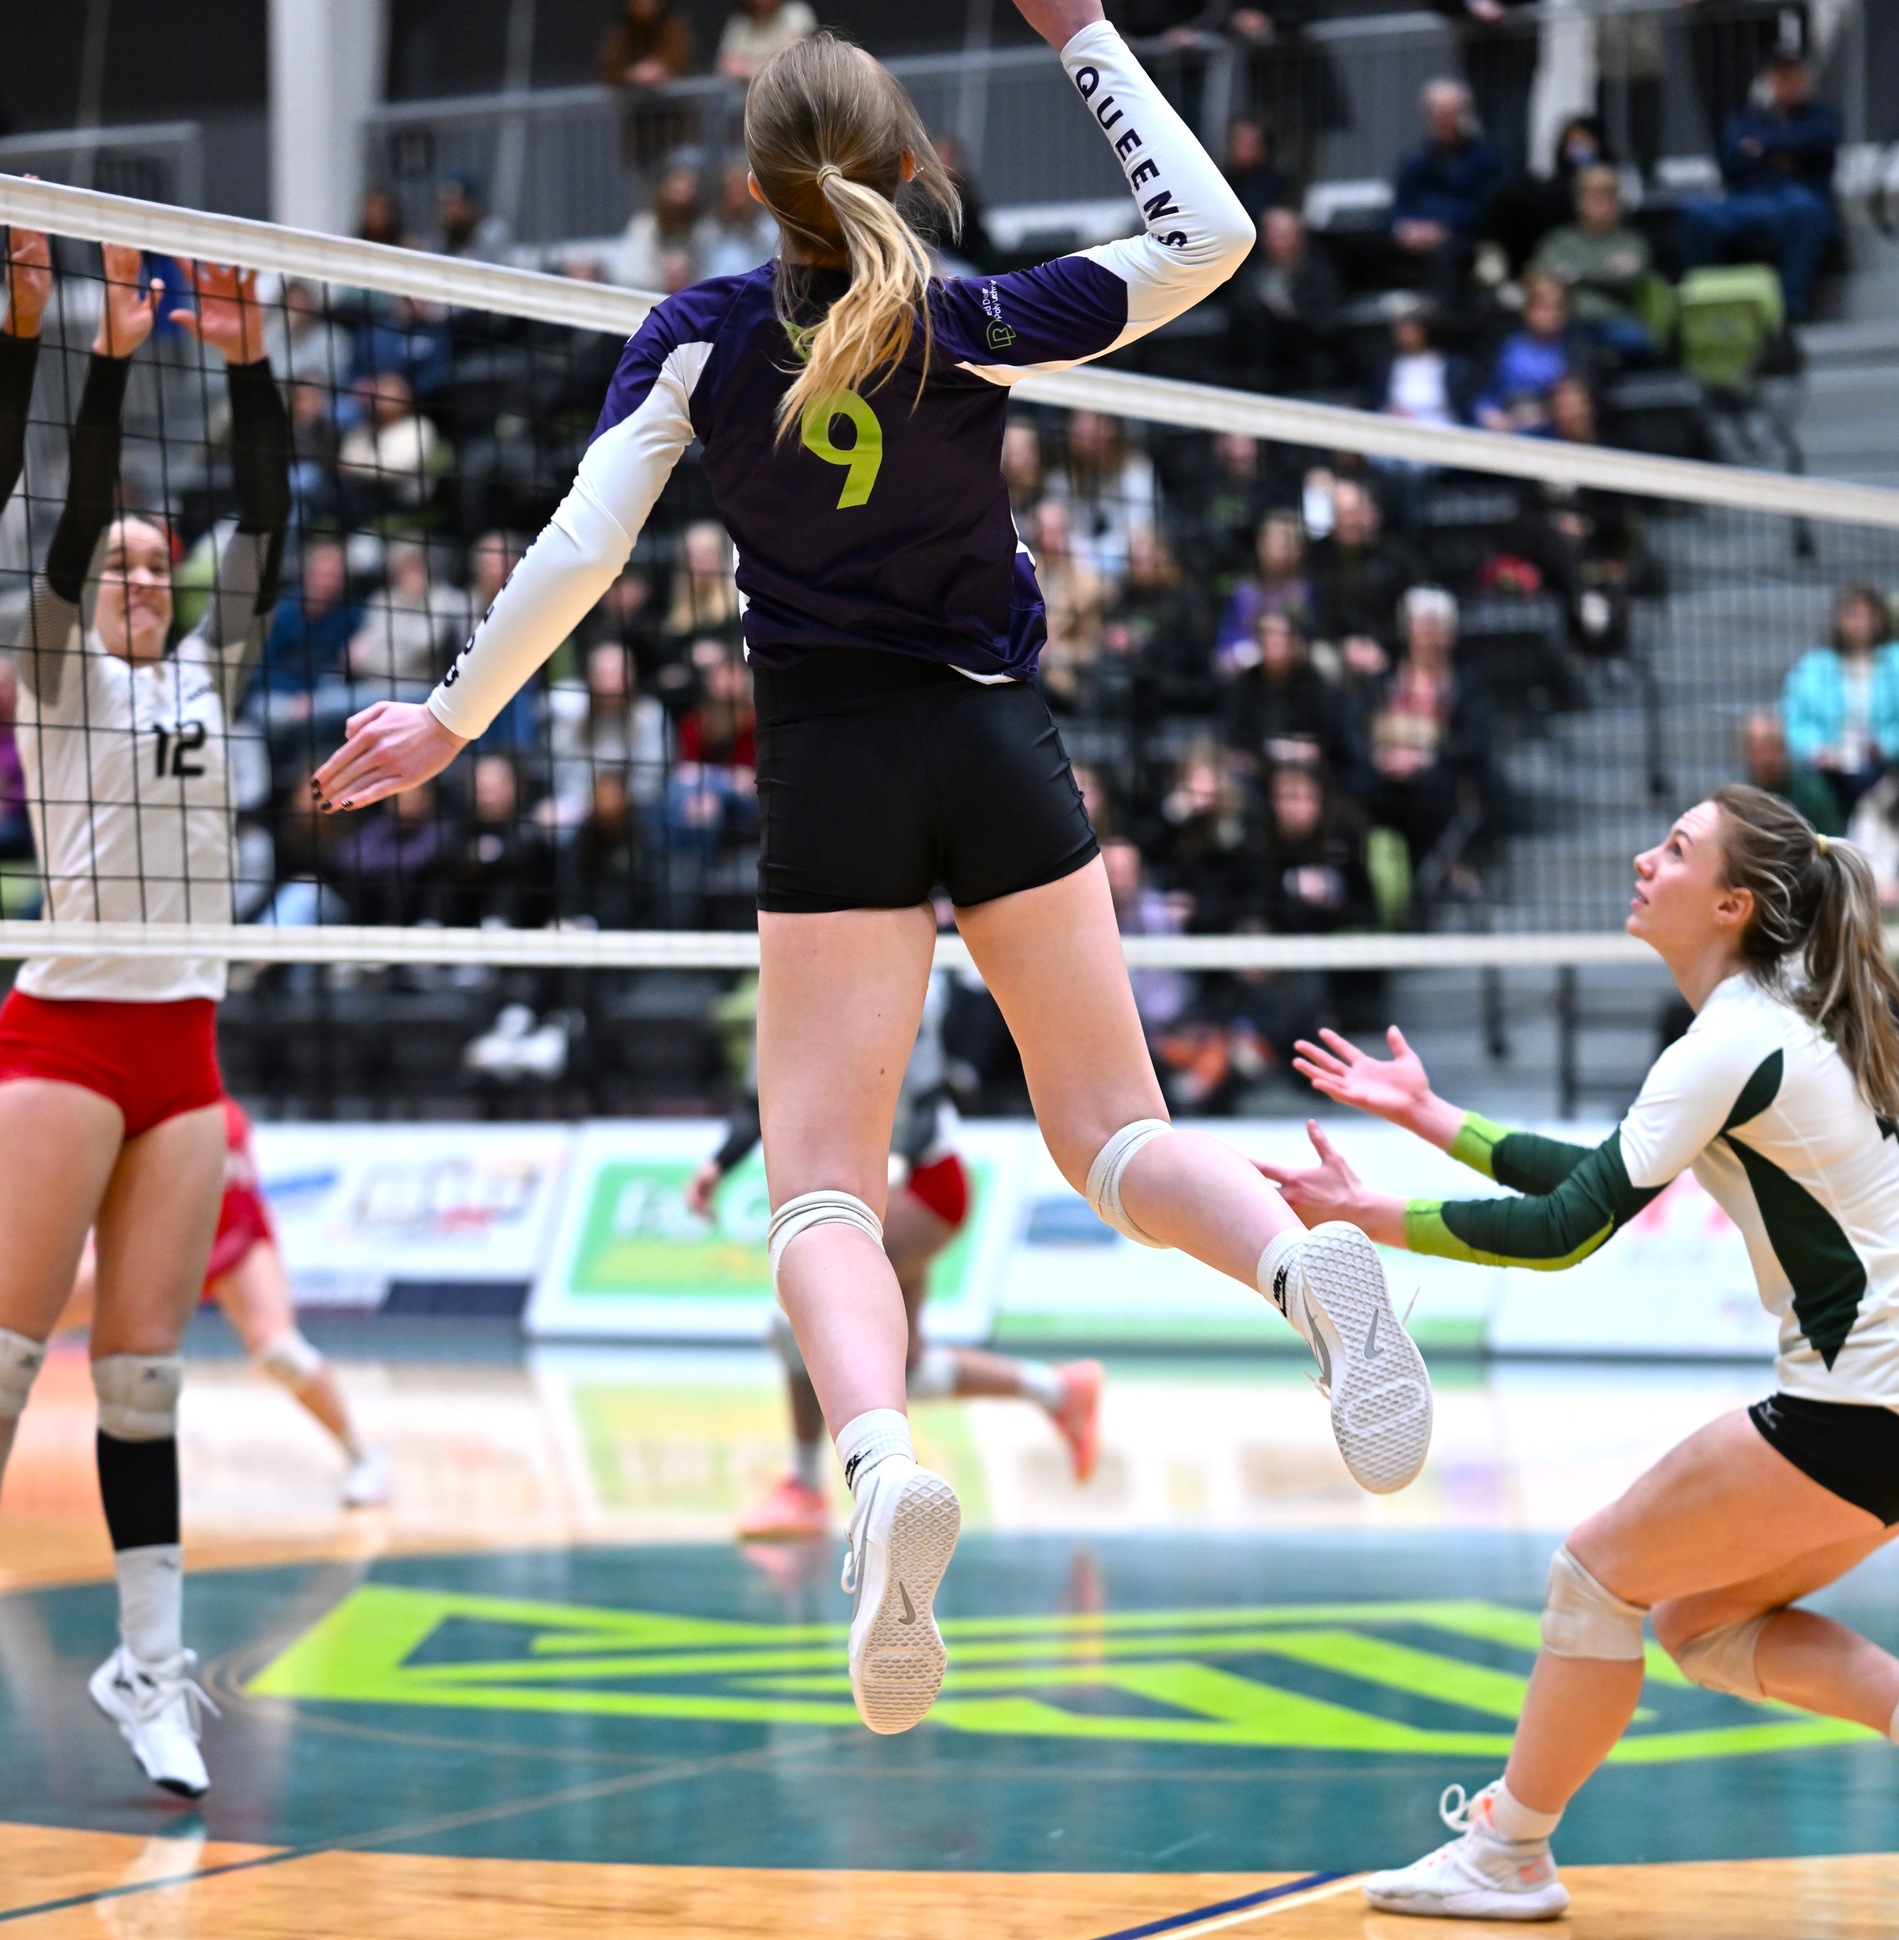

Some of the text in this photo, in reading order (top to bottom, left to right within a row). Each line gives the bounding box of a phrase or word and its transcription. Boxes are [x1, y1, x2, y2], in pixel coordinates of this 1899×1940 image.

[1075, 66, 1188, 248] QUEENS
[800, 387, 883, 510] 9
[152, 720, 206, 777] 12
